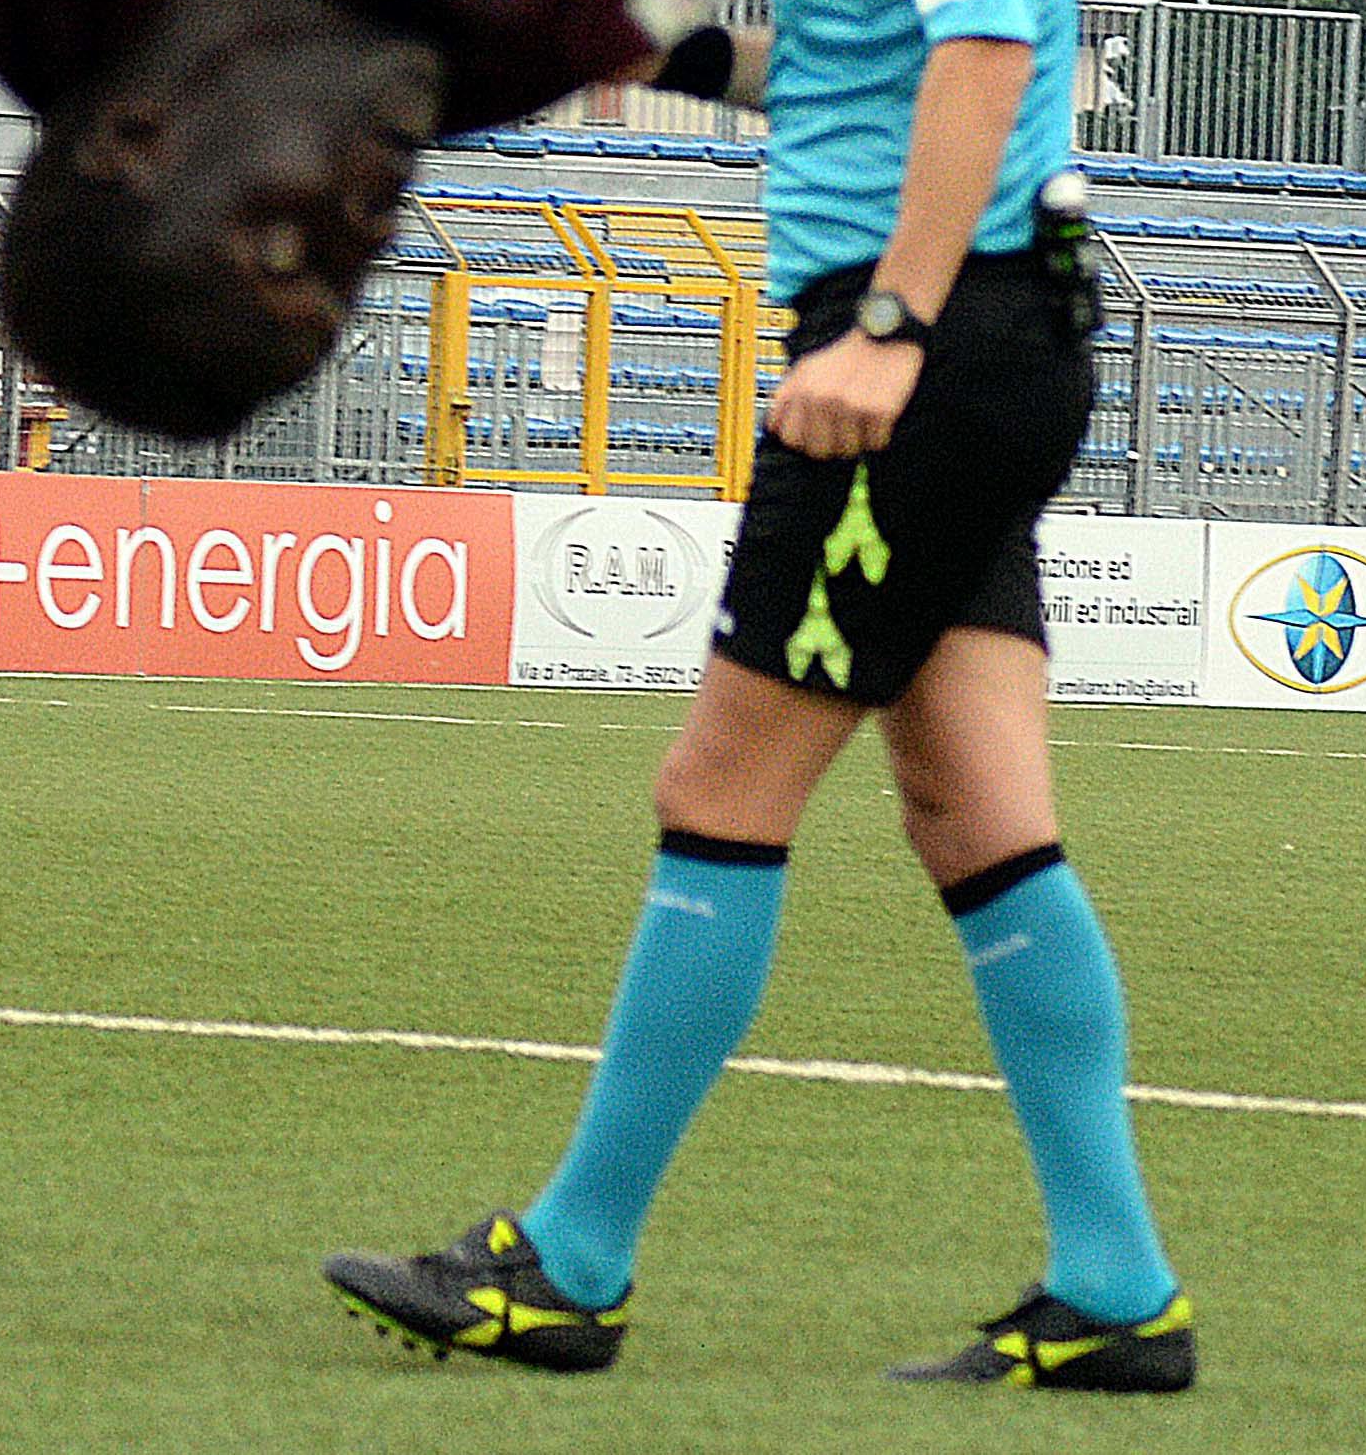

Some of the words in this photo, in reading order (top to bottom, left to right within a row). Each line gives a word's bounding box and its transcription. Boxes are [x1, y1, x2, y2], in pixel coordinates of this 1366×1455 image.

[566, 544, 676, 597] R.A.M.
[1108, 552, 1132, 580] ed
[1077, 597, 1100, 624] ed
[1105, 597, 1201, 626] industriali
